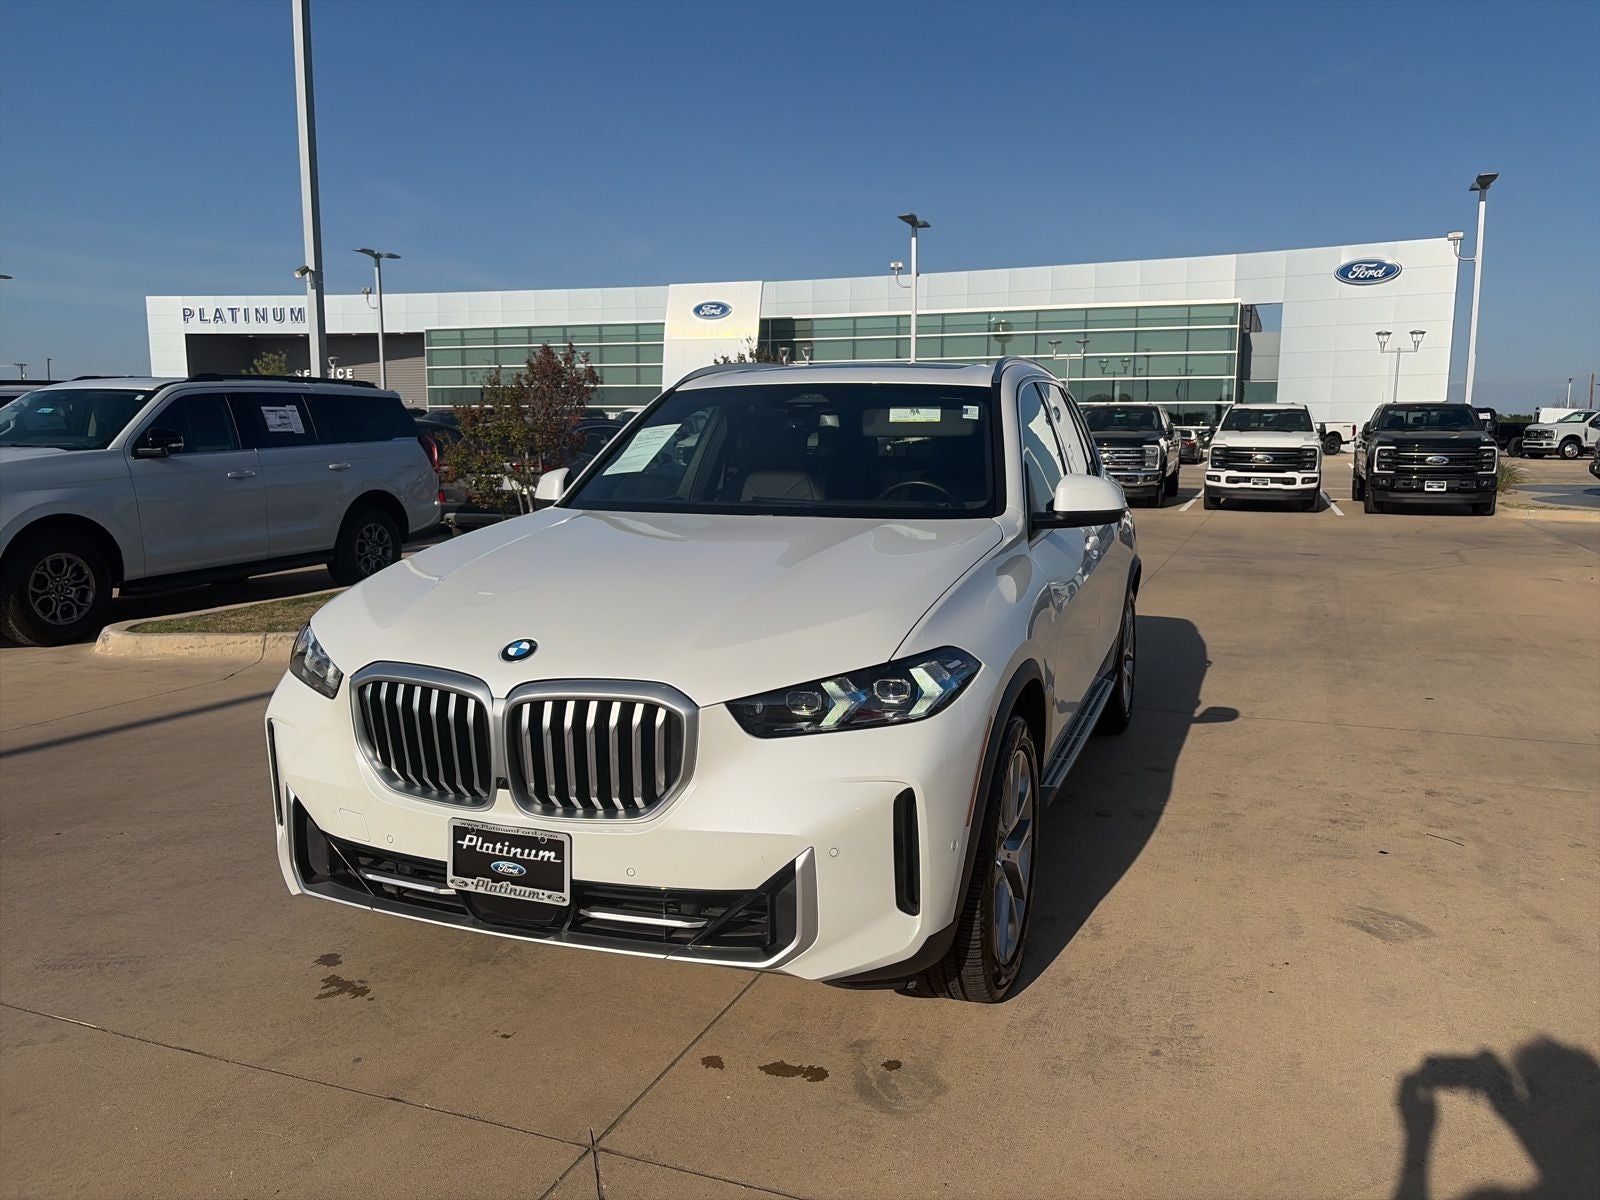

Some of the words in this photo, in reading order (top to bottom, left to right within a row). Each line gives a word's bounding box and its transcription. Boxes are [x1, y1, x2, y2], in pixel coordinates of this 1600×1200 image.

[1347, 263, 1387, 279] Ford
[182, 307, 306, 324] PLATINUM
[699, 304, 722, 316] Ford
[295, 368, 353, 379] SEICE
[457, 834, 562, 863] Platinum
[497, 863, 519, 874] Ford
[474, 878, 545, 901] Platinum
